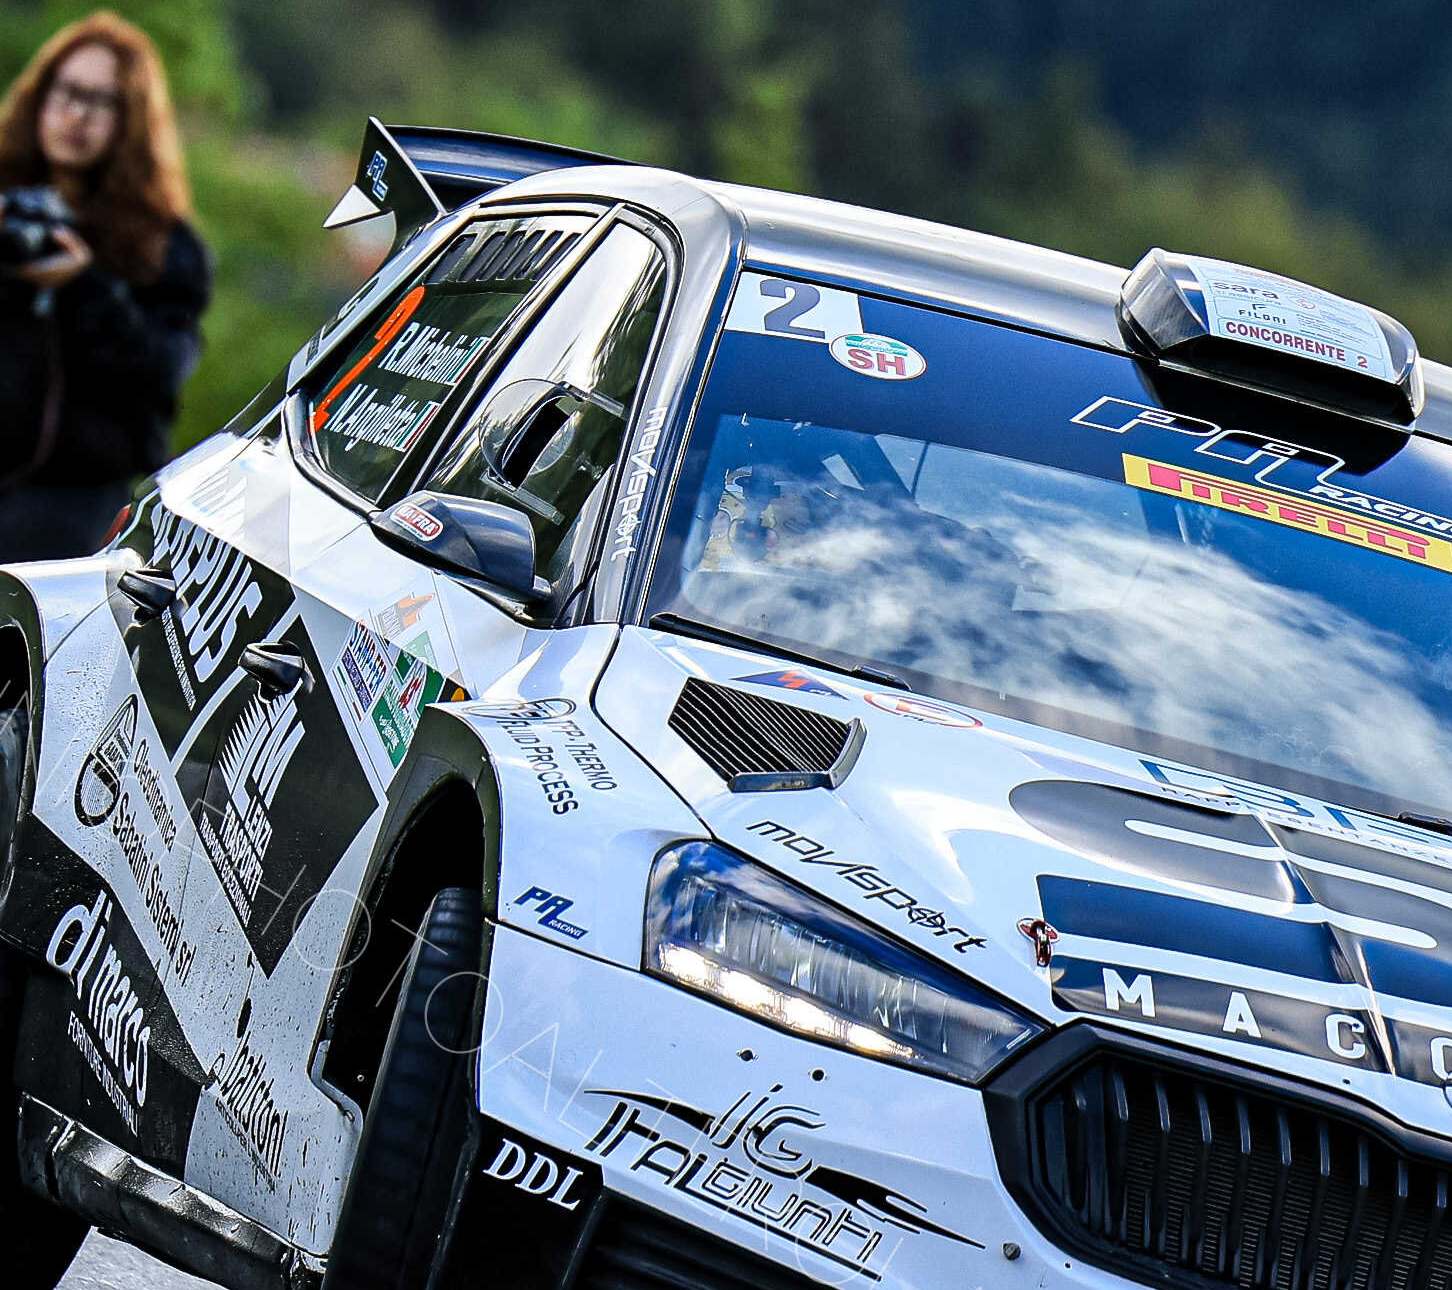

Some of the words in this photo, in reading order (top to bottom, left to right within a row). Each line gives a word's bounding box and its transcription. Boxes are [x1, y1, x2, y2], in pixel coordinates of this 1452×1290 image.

[760, 279, 826, 339] 2
[1225, 321, 1346, 362] CONCORRENTE
[1357, 355, 1369, 369] 2
[848, 349, 907, 376] SH
[1147, 463, 1431, 560] PIRELLI
[520, 744, 580, 816] PROCESS
[111, 792, 154, 894] Sabatini
[219, 800, 264, 902] TRASPORTI
[548, 919, 584, 937] RACING
[46, 890, 113, 1000] di
[87, 943, 151, 1108] marco
[482, 1137, 585, 1212] DDL
